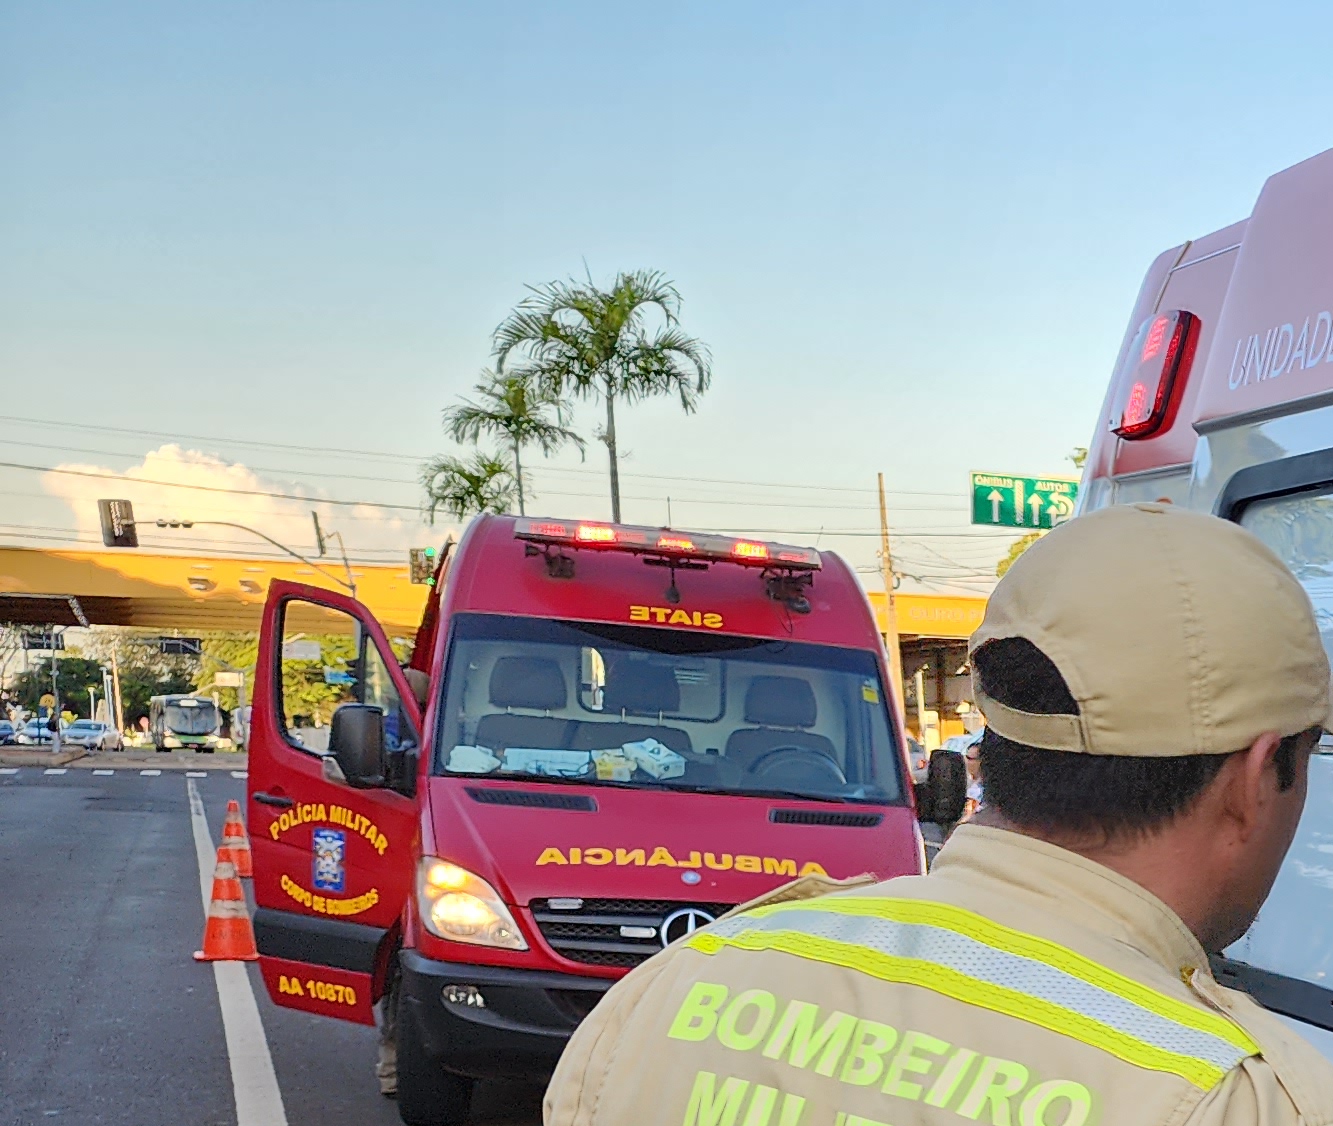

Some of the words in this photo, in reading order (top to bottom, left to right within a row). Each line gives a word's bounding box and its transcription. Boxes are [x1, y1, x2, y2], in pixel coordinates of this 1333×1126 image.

[269, 802, 327, 841] POLÍCIA
[329, 804, 389, 856] MILITAR
[279, 975, 304, 997] AA
